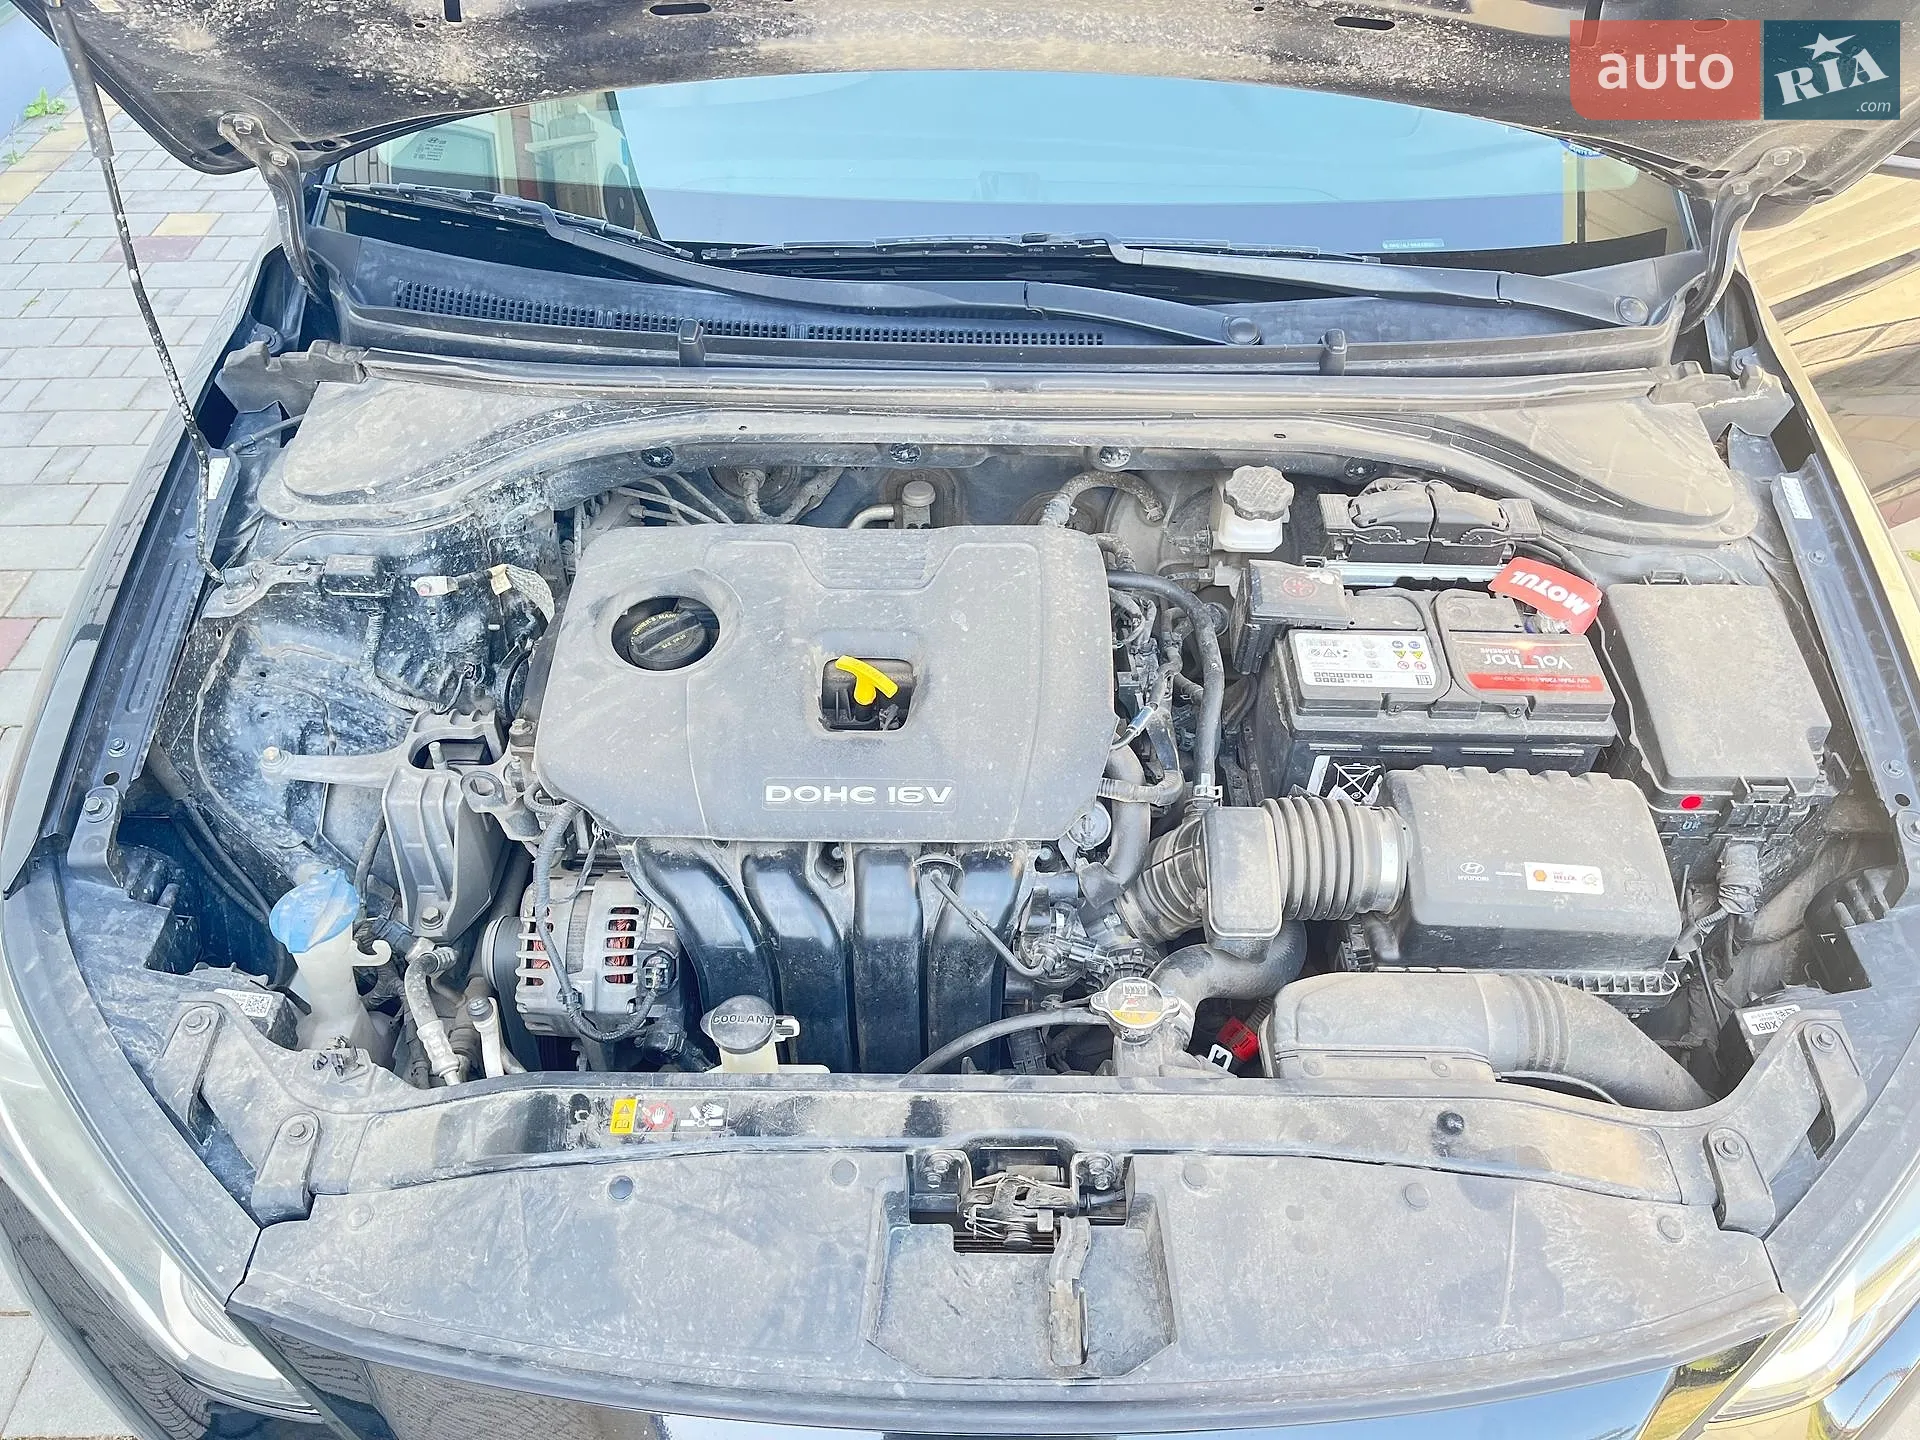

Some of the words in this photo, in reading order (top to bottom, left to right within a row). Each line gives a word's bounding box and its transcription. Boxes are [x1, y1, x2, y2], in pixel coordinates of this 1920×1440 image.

[1509, 570, 1591, 616] MOTUL
[766, 786, 876, 804] DOHC
[888, 786, 952, 804] 16V
[713, 1014, 774, 1024] COOLANT
